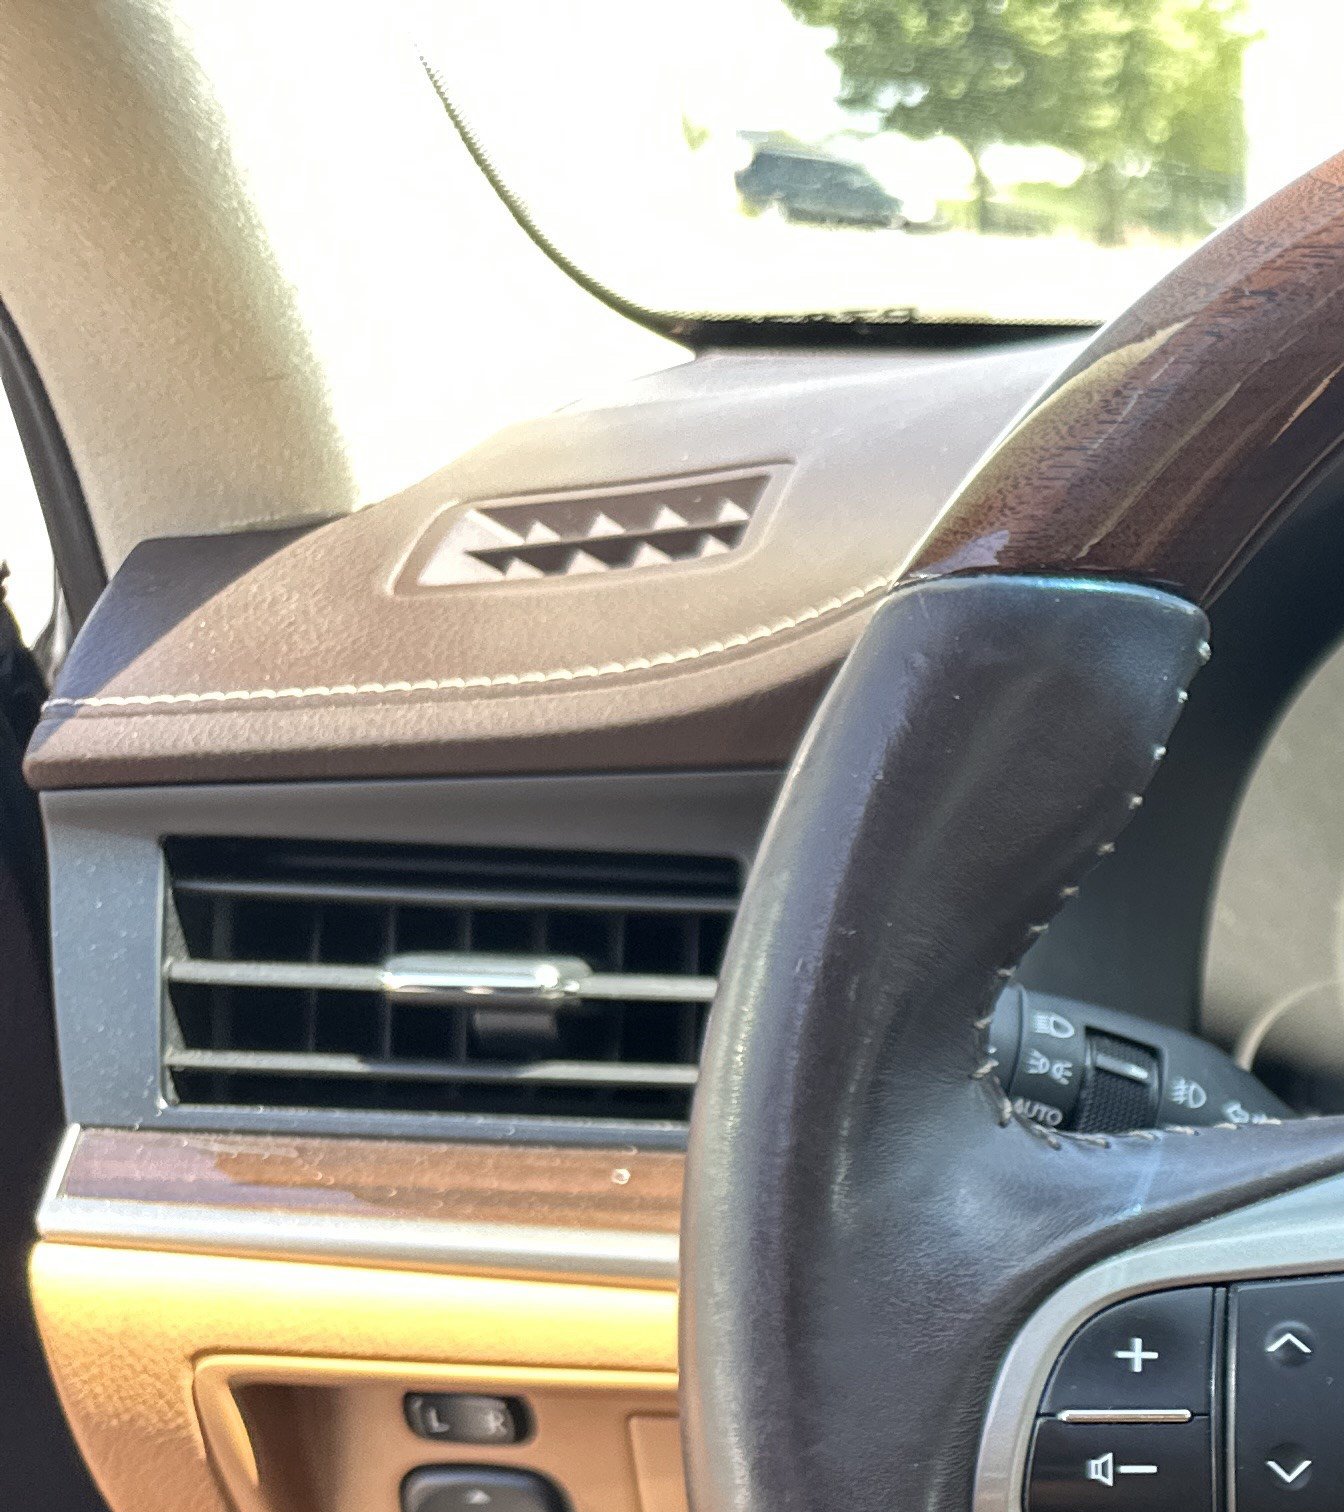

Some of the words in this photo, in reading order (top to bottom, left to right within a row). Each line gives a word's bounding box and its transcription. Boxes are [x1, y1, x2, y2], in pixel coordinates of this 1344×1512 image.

[1011, 1098, 1064, 1127] AUTO
[426, 1407, 449, 1433] L
[484, 1409, 508, 1435] R
